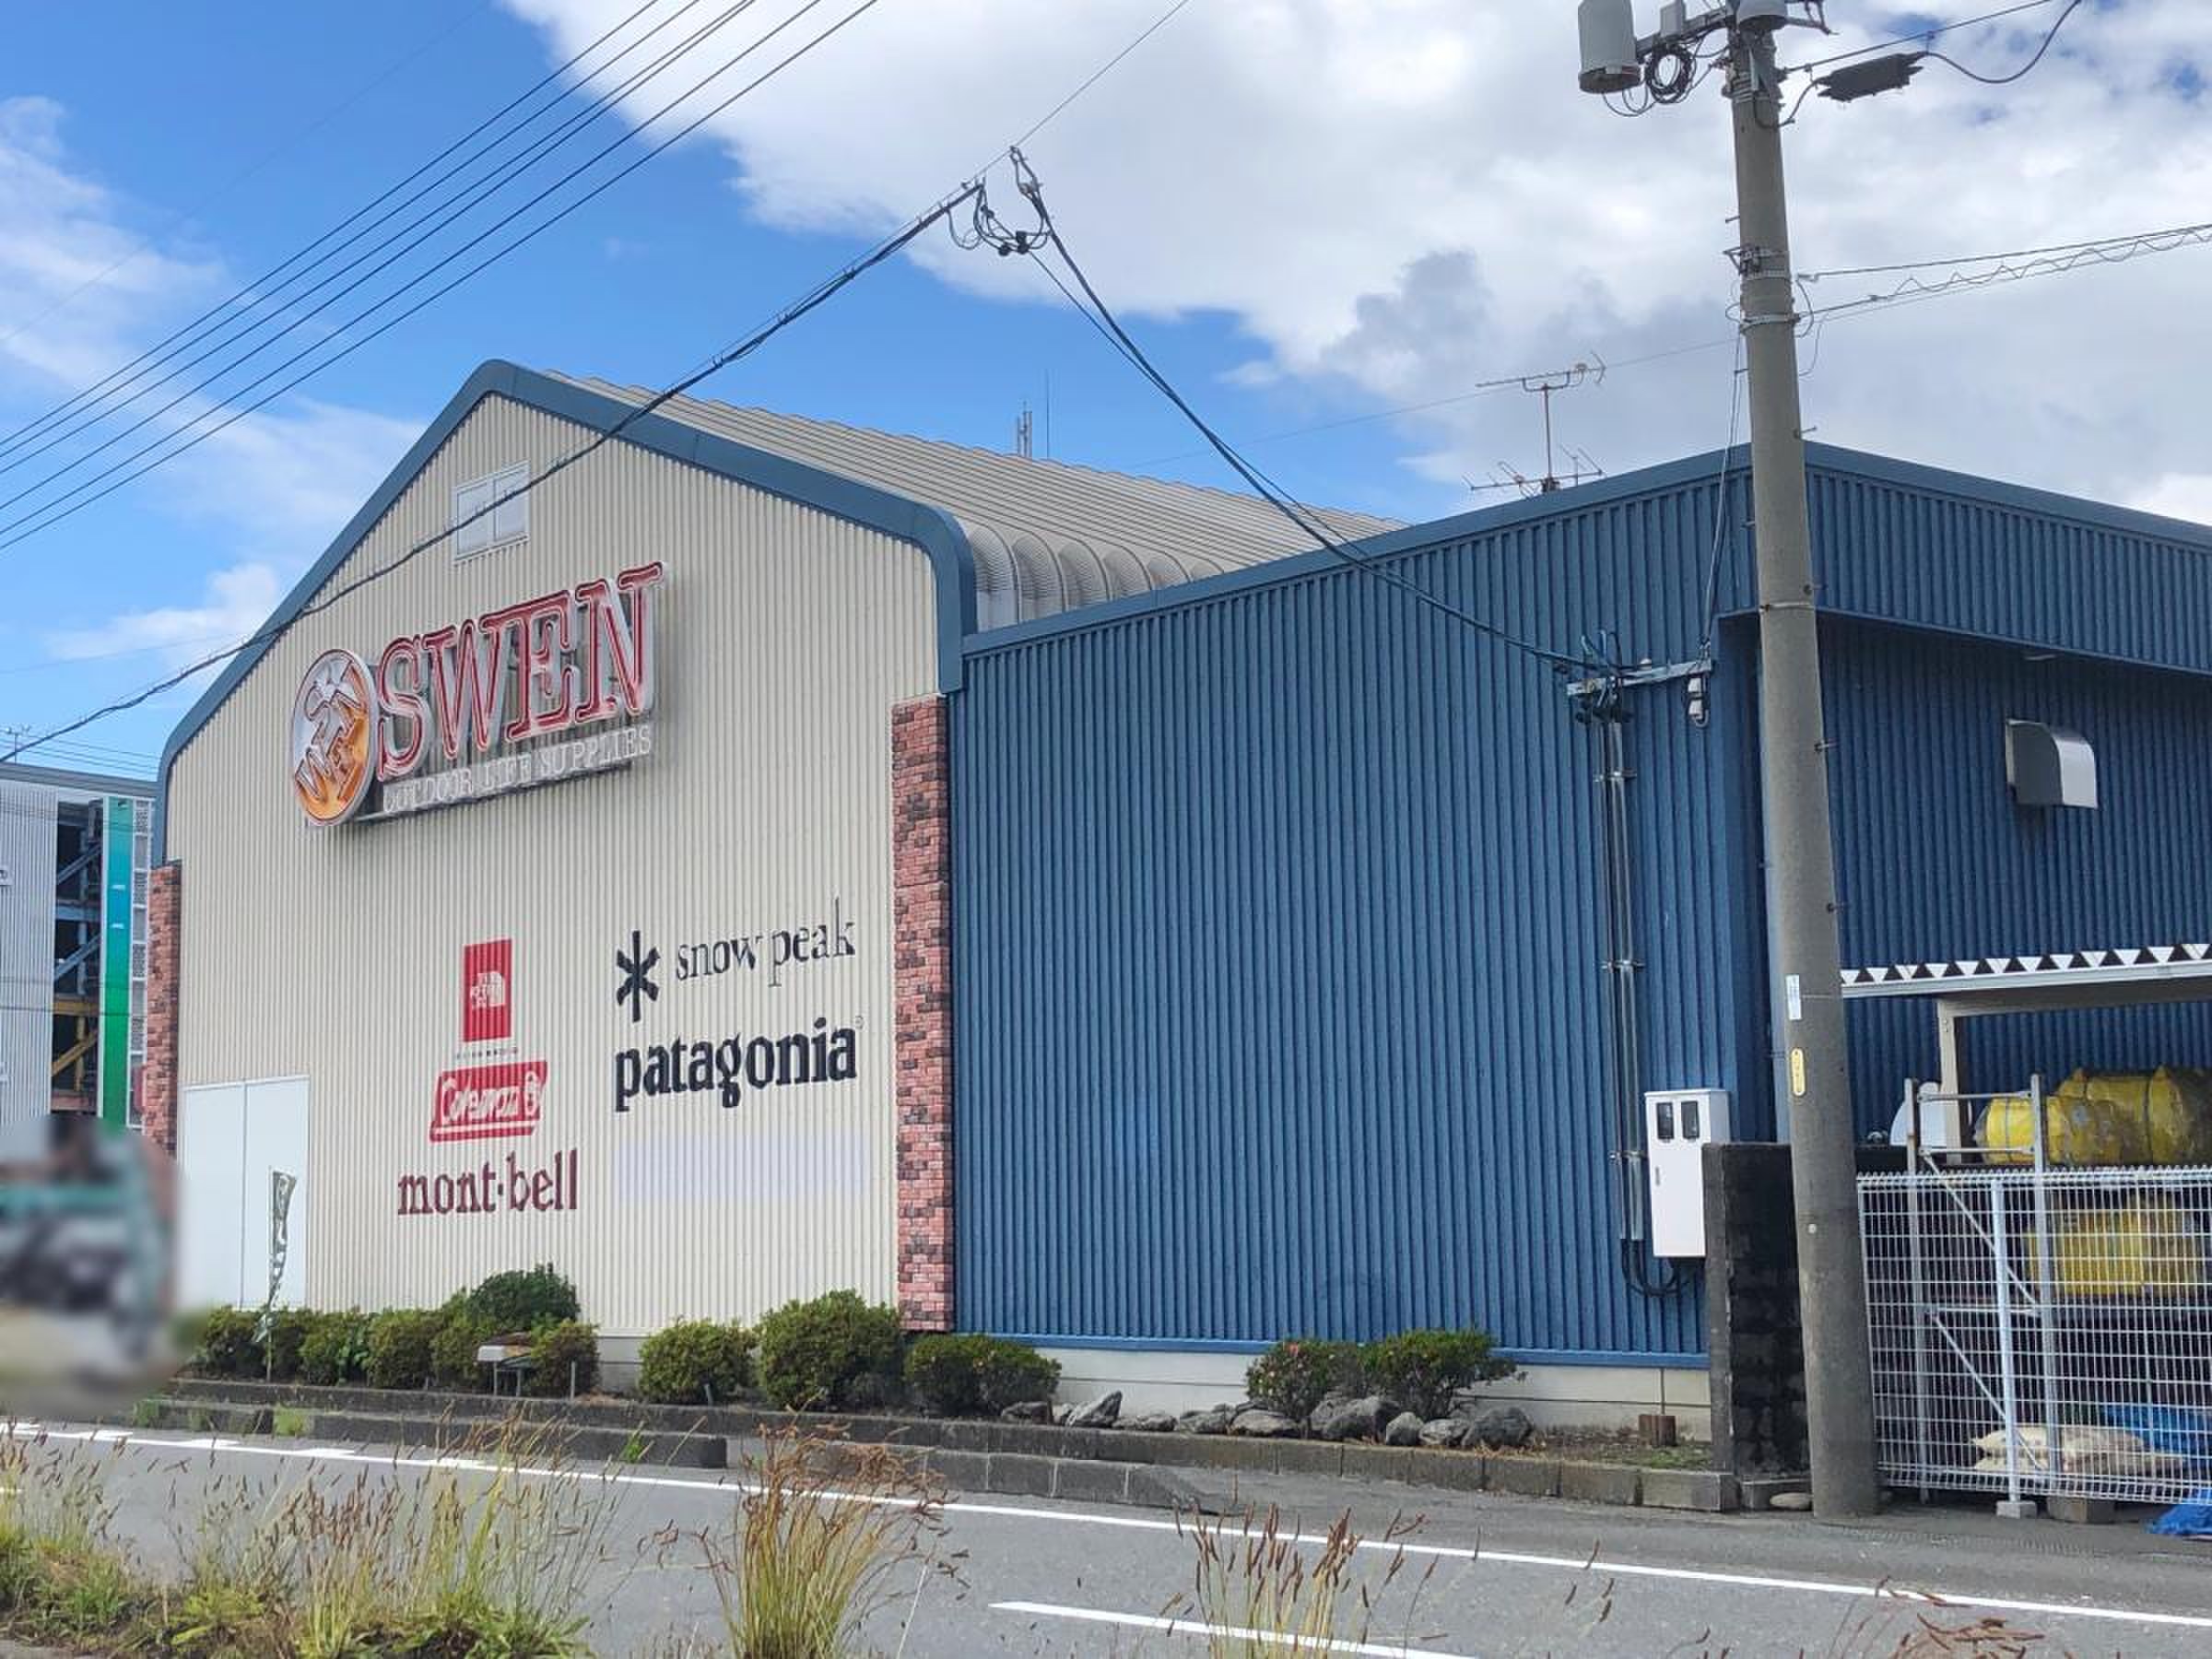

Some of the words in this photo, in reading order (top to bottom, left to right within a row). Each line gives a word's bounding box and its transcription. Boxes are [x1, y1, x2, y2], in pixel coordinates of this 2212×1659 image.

[378, 560, 664, 782] SWEN
[538, 724, 652, 777] SUPPLIES
[677, 935, 764, 981] snow
[768, 897, 856, 987] peak
[615, 1017, 858, 1112] patagonia
